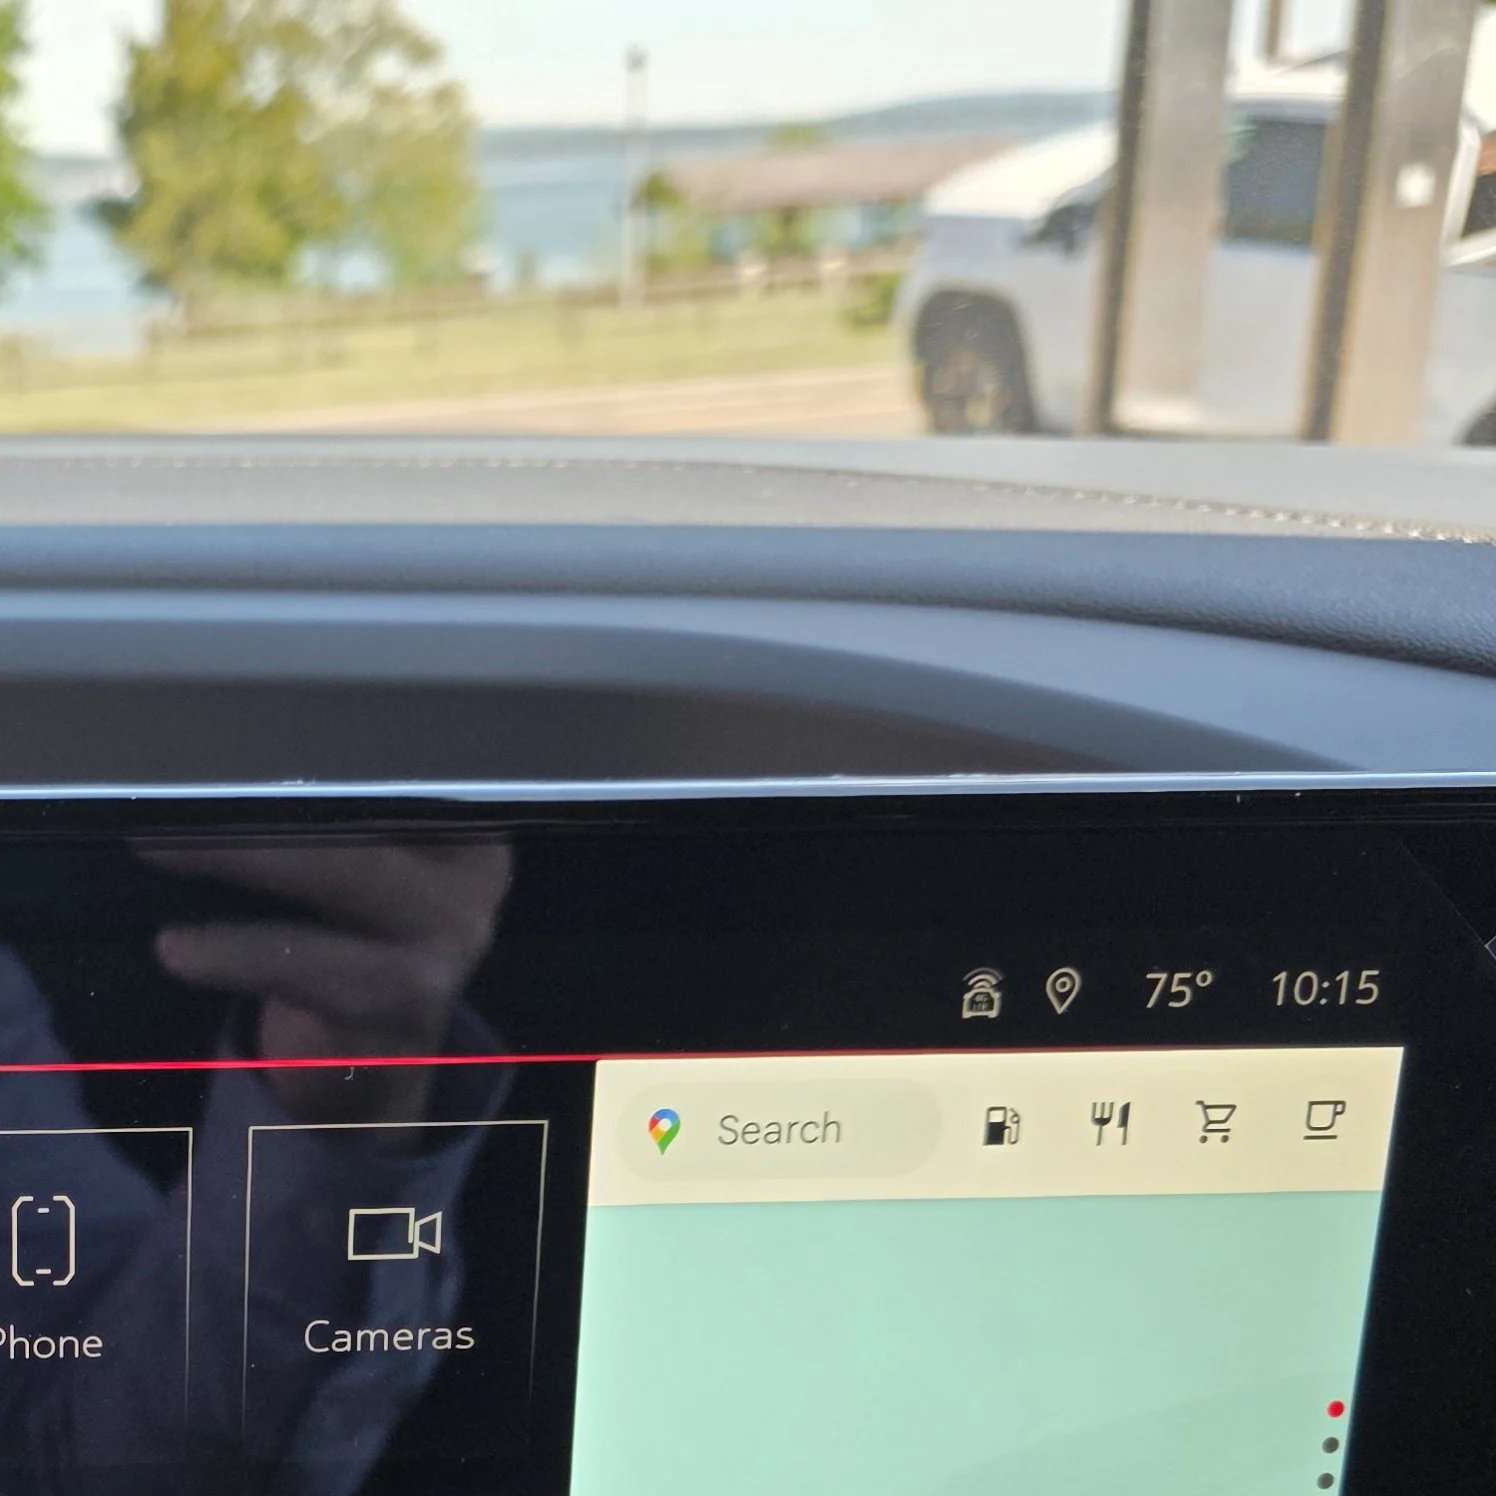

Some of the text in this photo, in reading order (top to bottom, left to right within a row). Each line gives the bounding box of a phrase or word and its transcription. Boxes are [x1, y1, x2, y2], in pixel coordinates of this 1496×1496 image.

[1145, 970, 1214, 1009] 75°
[1272, 969, 1380, 1006] 10:15
[717, 1110, 841, 1146] Search
[304, 1319, 475, 1353] Cameras
